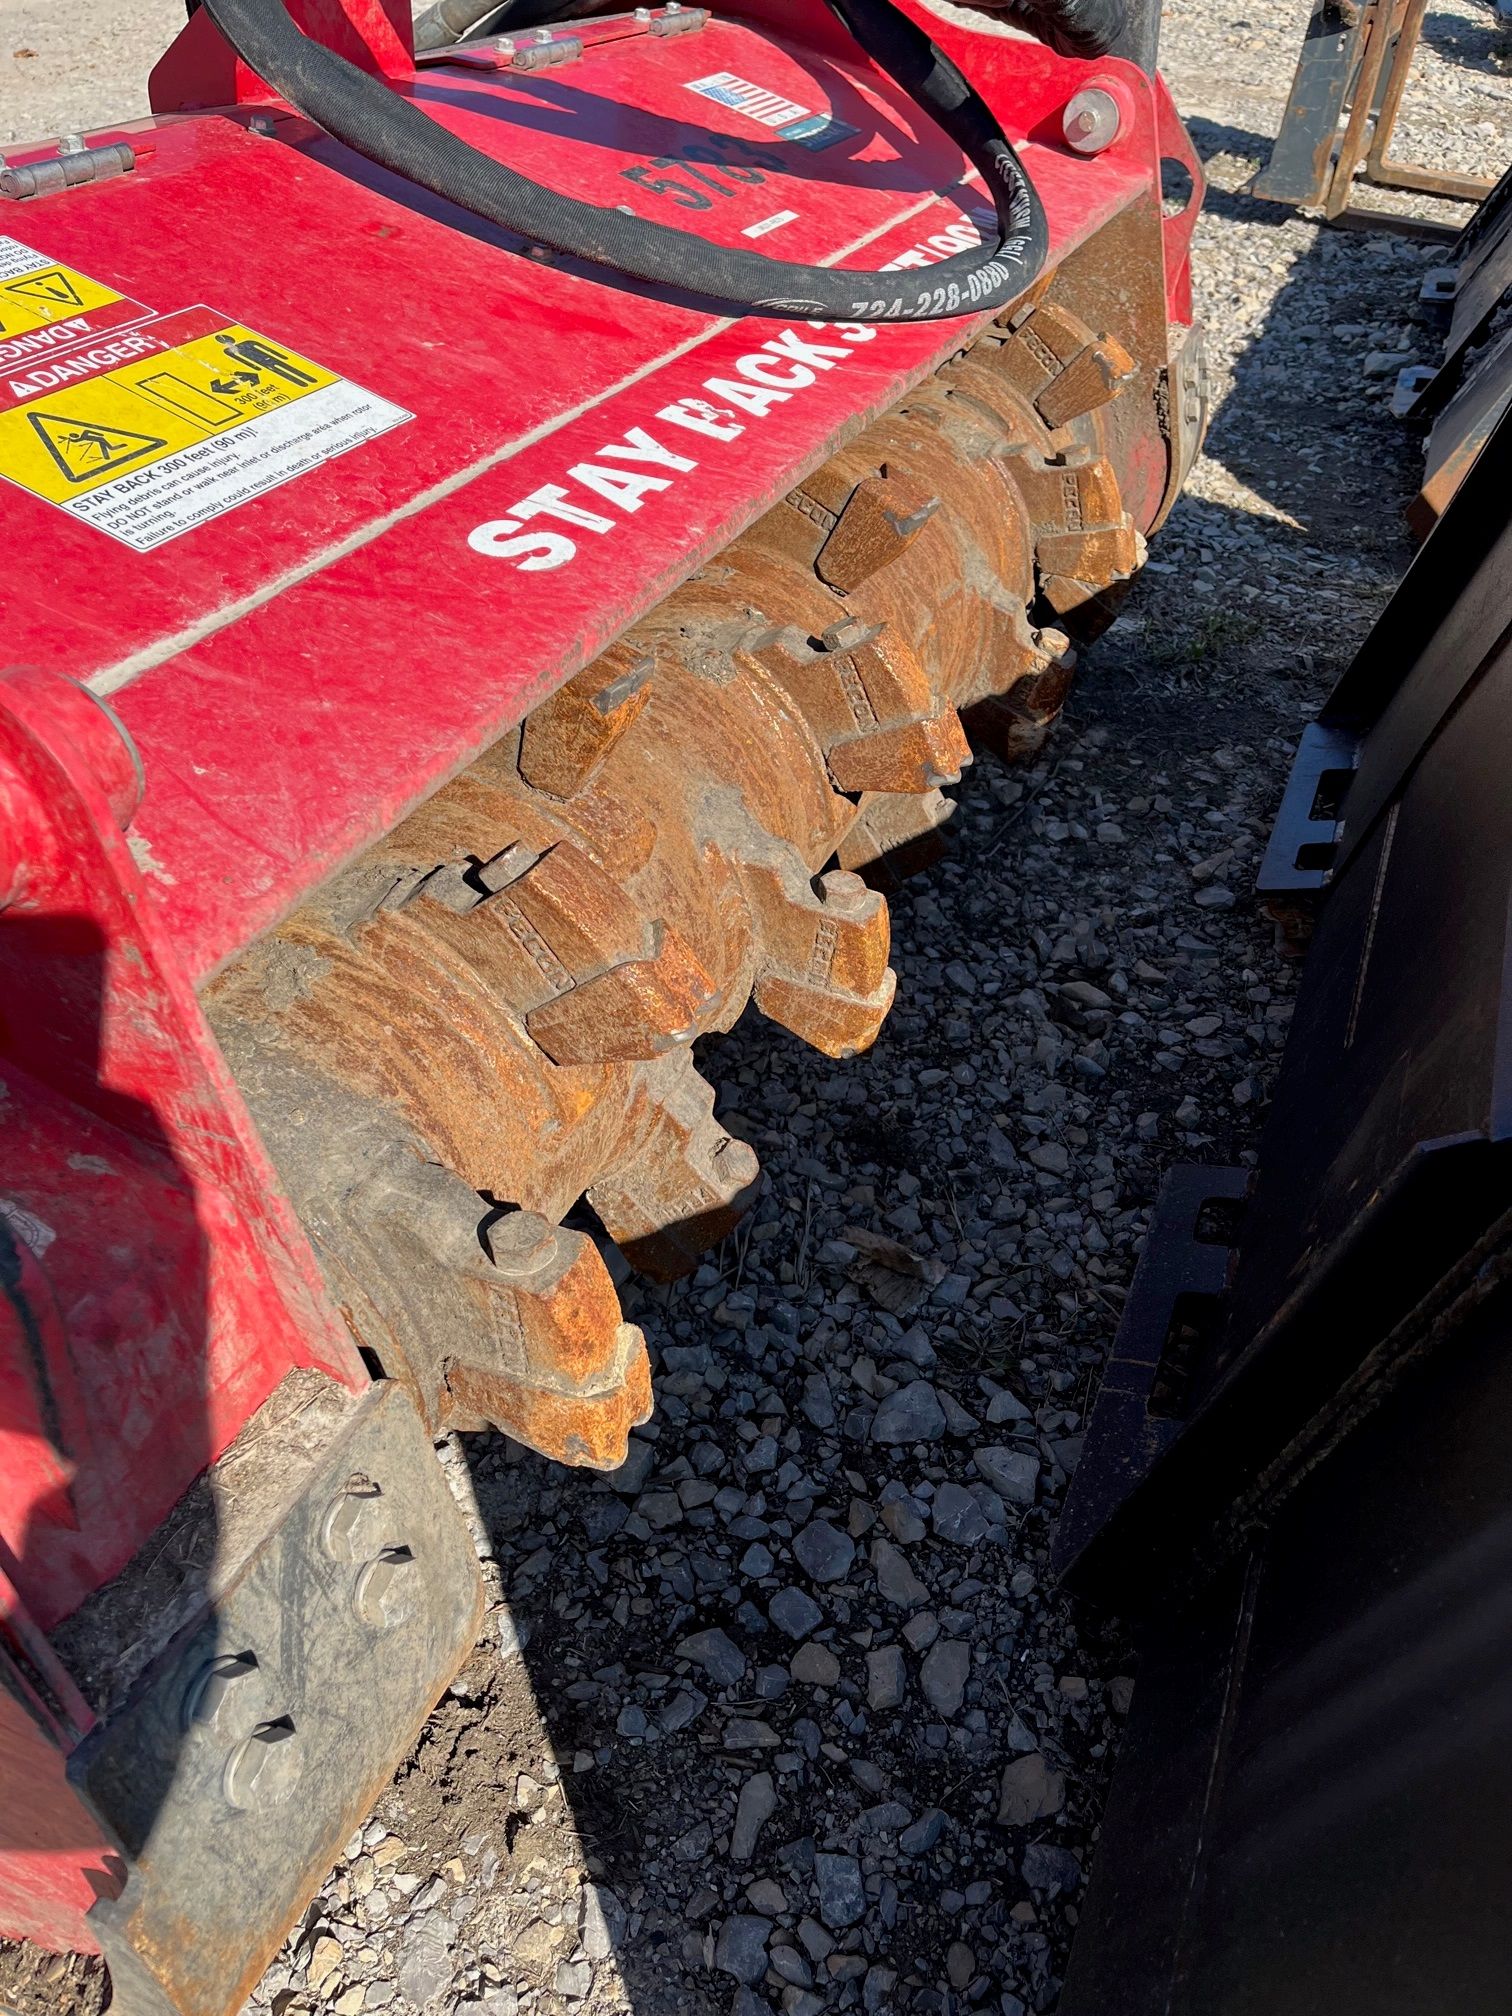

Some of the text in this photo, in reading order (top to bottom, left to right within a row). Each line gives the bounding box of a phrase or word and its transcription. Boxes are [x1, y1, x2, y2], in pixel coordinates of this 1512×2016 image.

[24, 259, 50, 270] STAY
[850, 261, 1010, 319] 724-228-0880
[26, 337, 157, 388] DANGER
[234, 392, 258, 405] 300
[272, 392, 291, 403] m)
[72, 427, 258, 512] STAY BACK 300 feet (90 m)!
[107, 403, 373, 530] DO NOT stand or walk near inlet or discharge area when rotor
[467, 425, 699, 571] STAY
[655, 328, 854, 443] BACK
[92, 452, 241, 522] Flying debris can cause injury.
[136, 426, 378, 545] Failure to comply could result in death or serious injury.
[120, 509, 177, 537] is turning.
